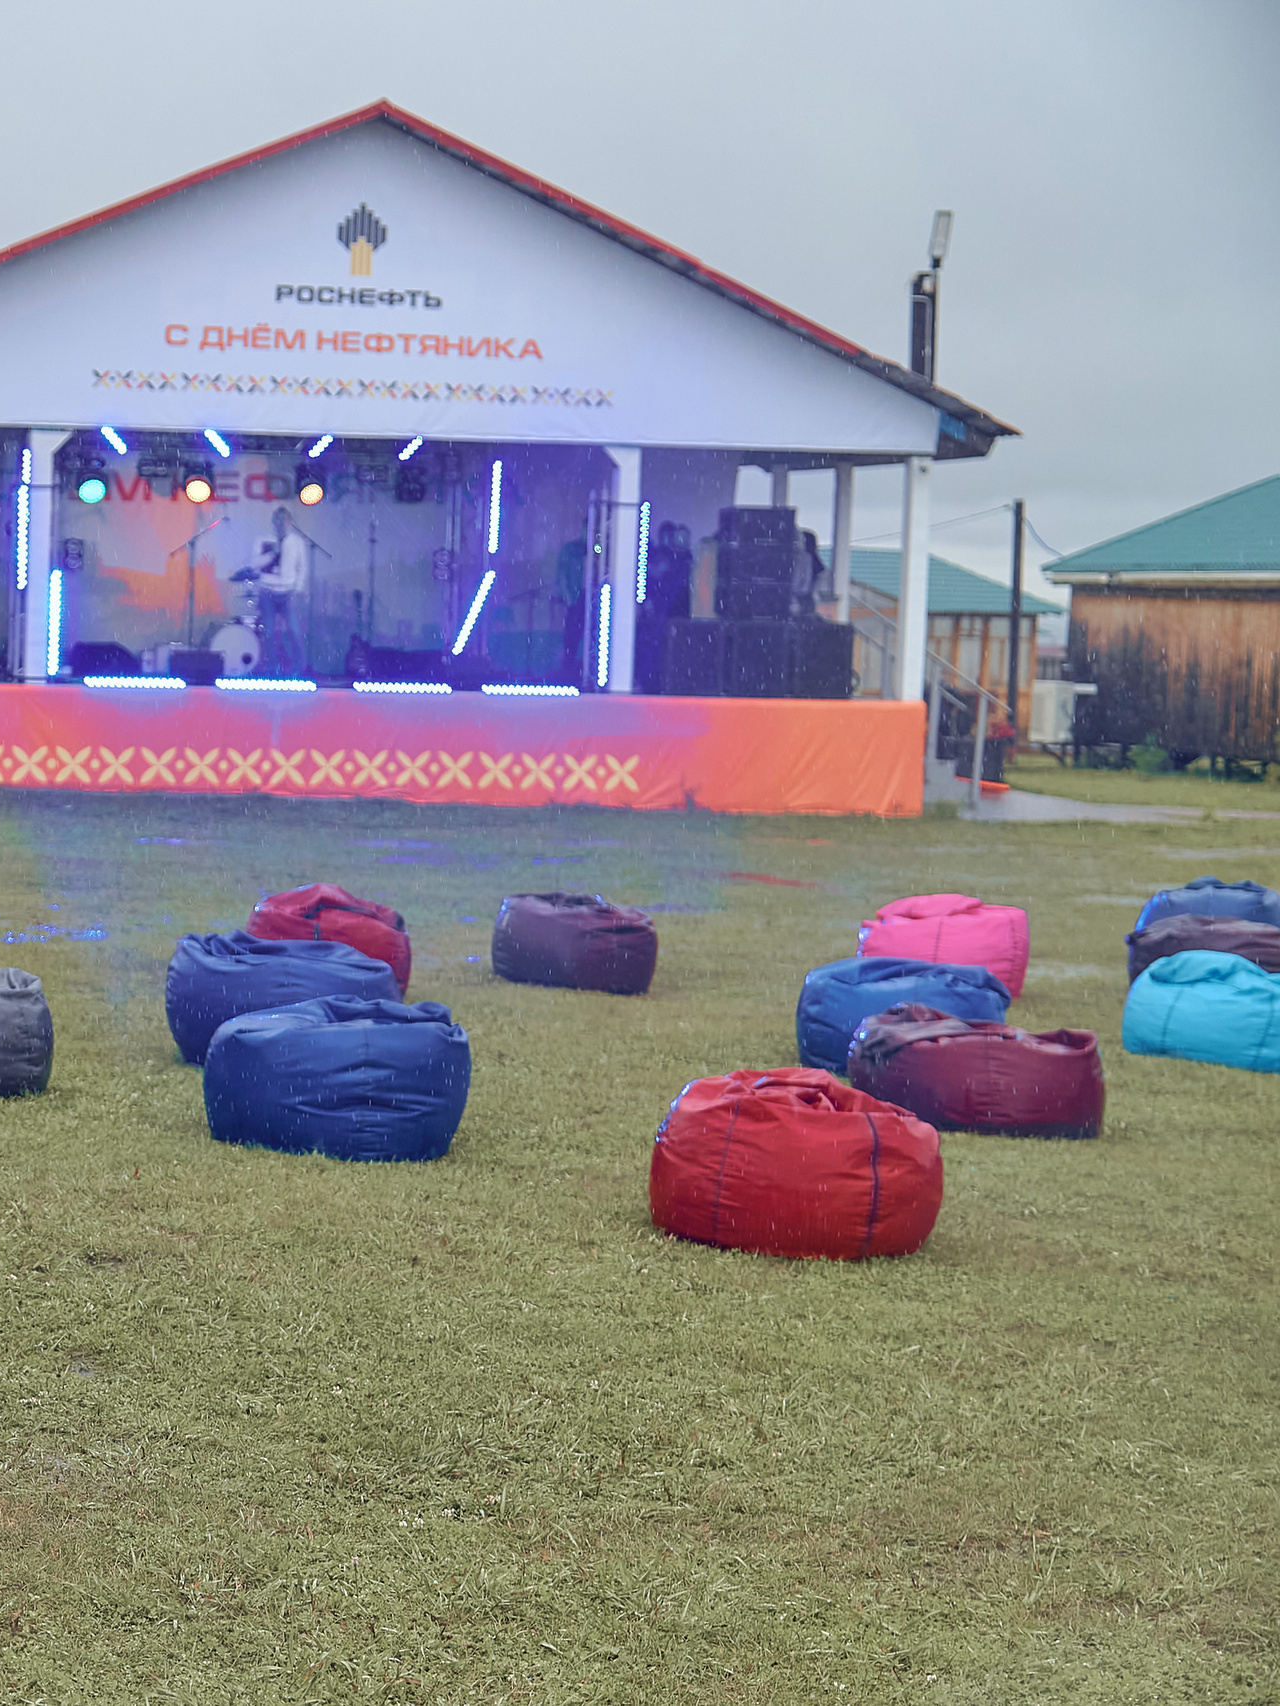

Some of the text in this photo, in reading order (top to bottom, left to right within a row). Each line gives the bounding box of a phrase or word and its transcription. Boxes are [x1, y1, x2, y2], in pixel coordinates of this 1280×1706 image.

[275, 284, 443, 309] РОСНЕФТЬ
[165, 323, 543, 360] С ДНЁМ НЕФТЯНИКА
